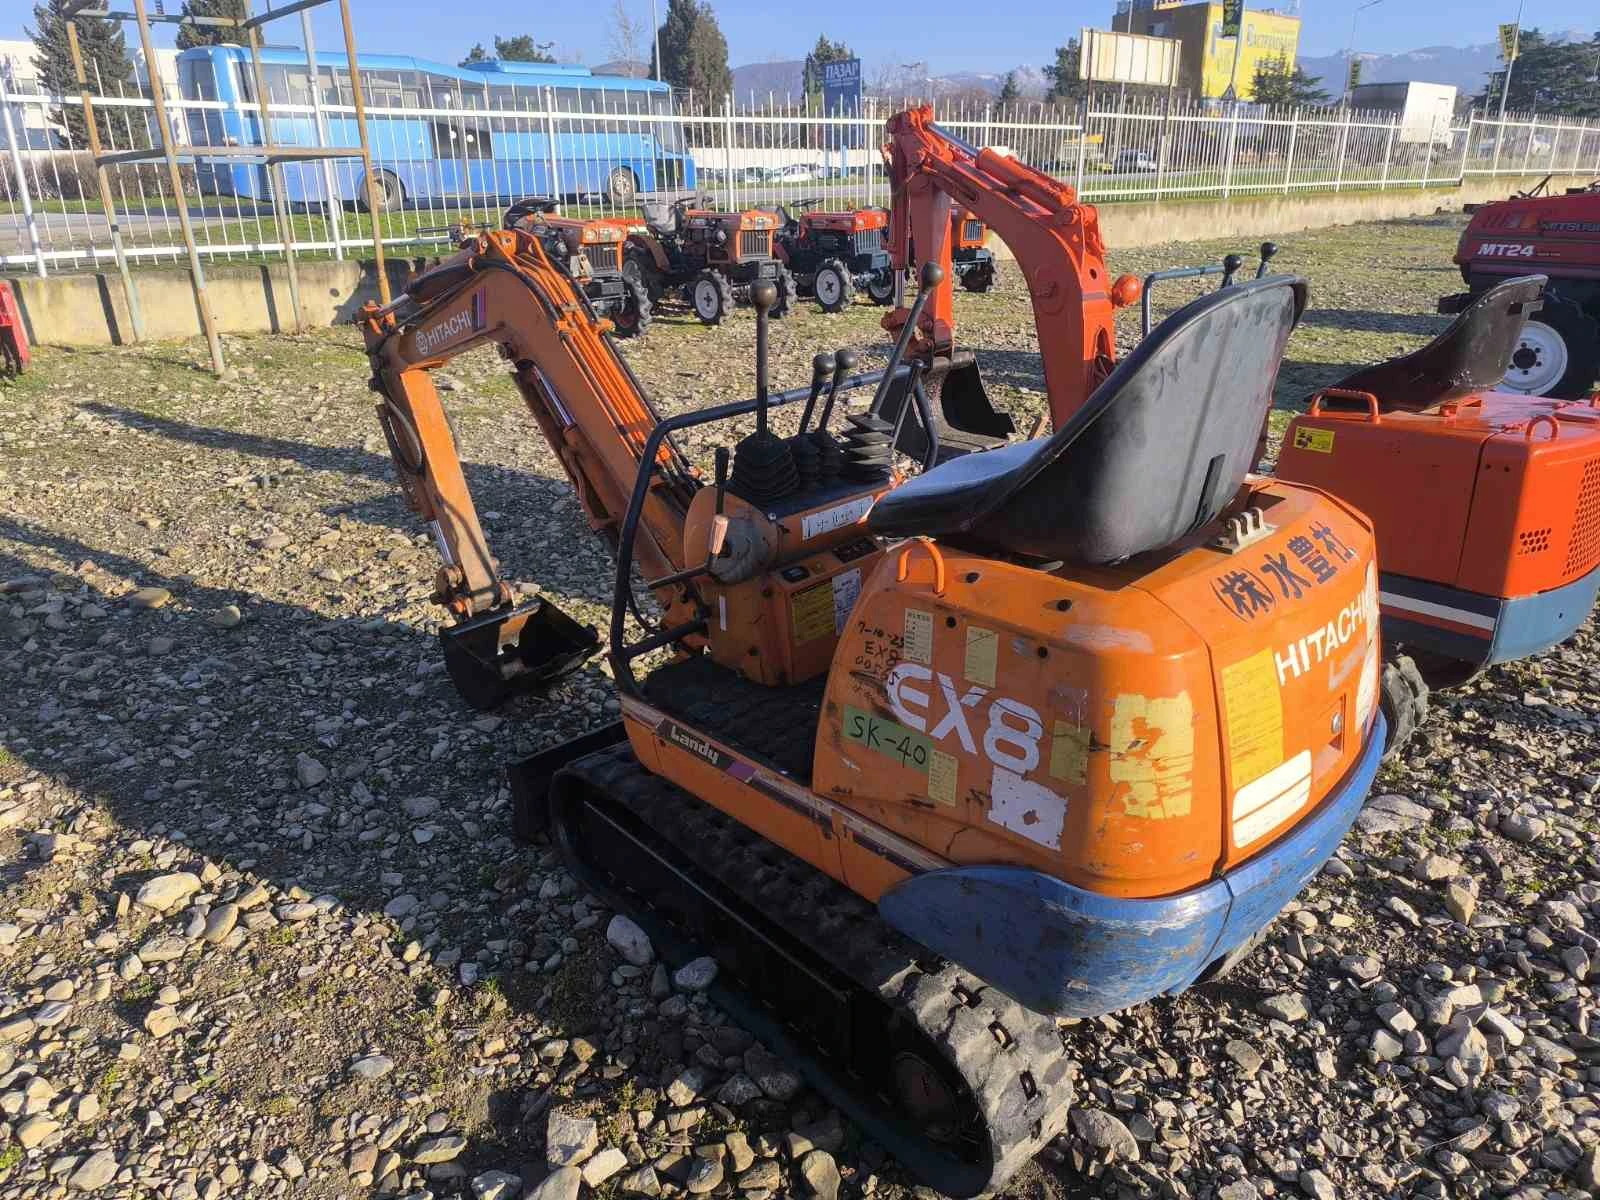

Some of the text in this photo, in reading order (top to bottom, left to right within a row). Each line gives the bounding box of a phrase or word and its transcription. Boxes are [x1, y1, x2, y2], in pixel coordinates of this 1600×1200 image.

[1477, 243, 1536, 257] MT24
[427, 310, 472, 347] HITACHI
[1275, 588, 1369, 686] HITACHI
[850, 715, 927, 769] SK-40
[886, 662, 1044, 776] EX8
[670, 724, 720, 765] Landy
